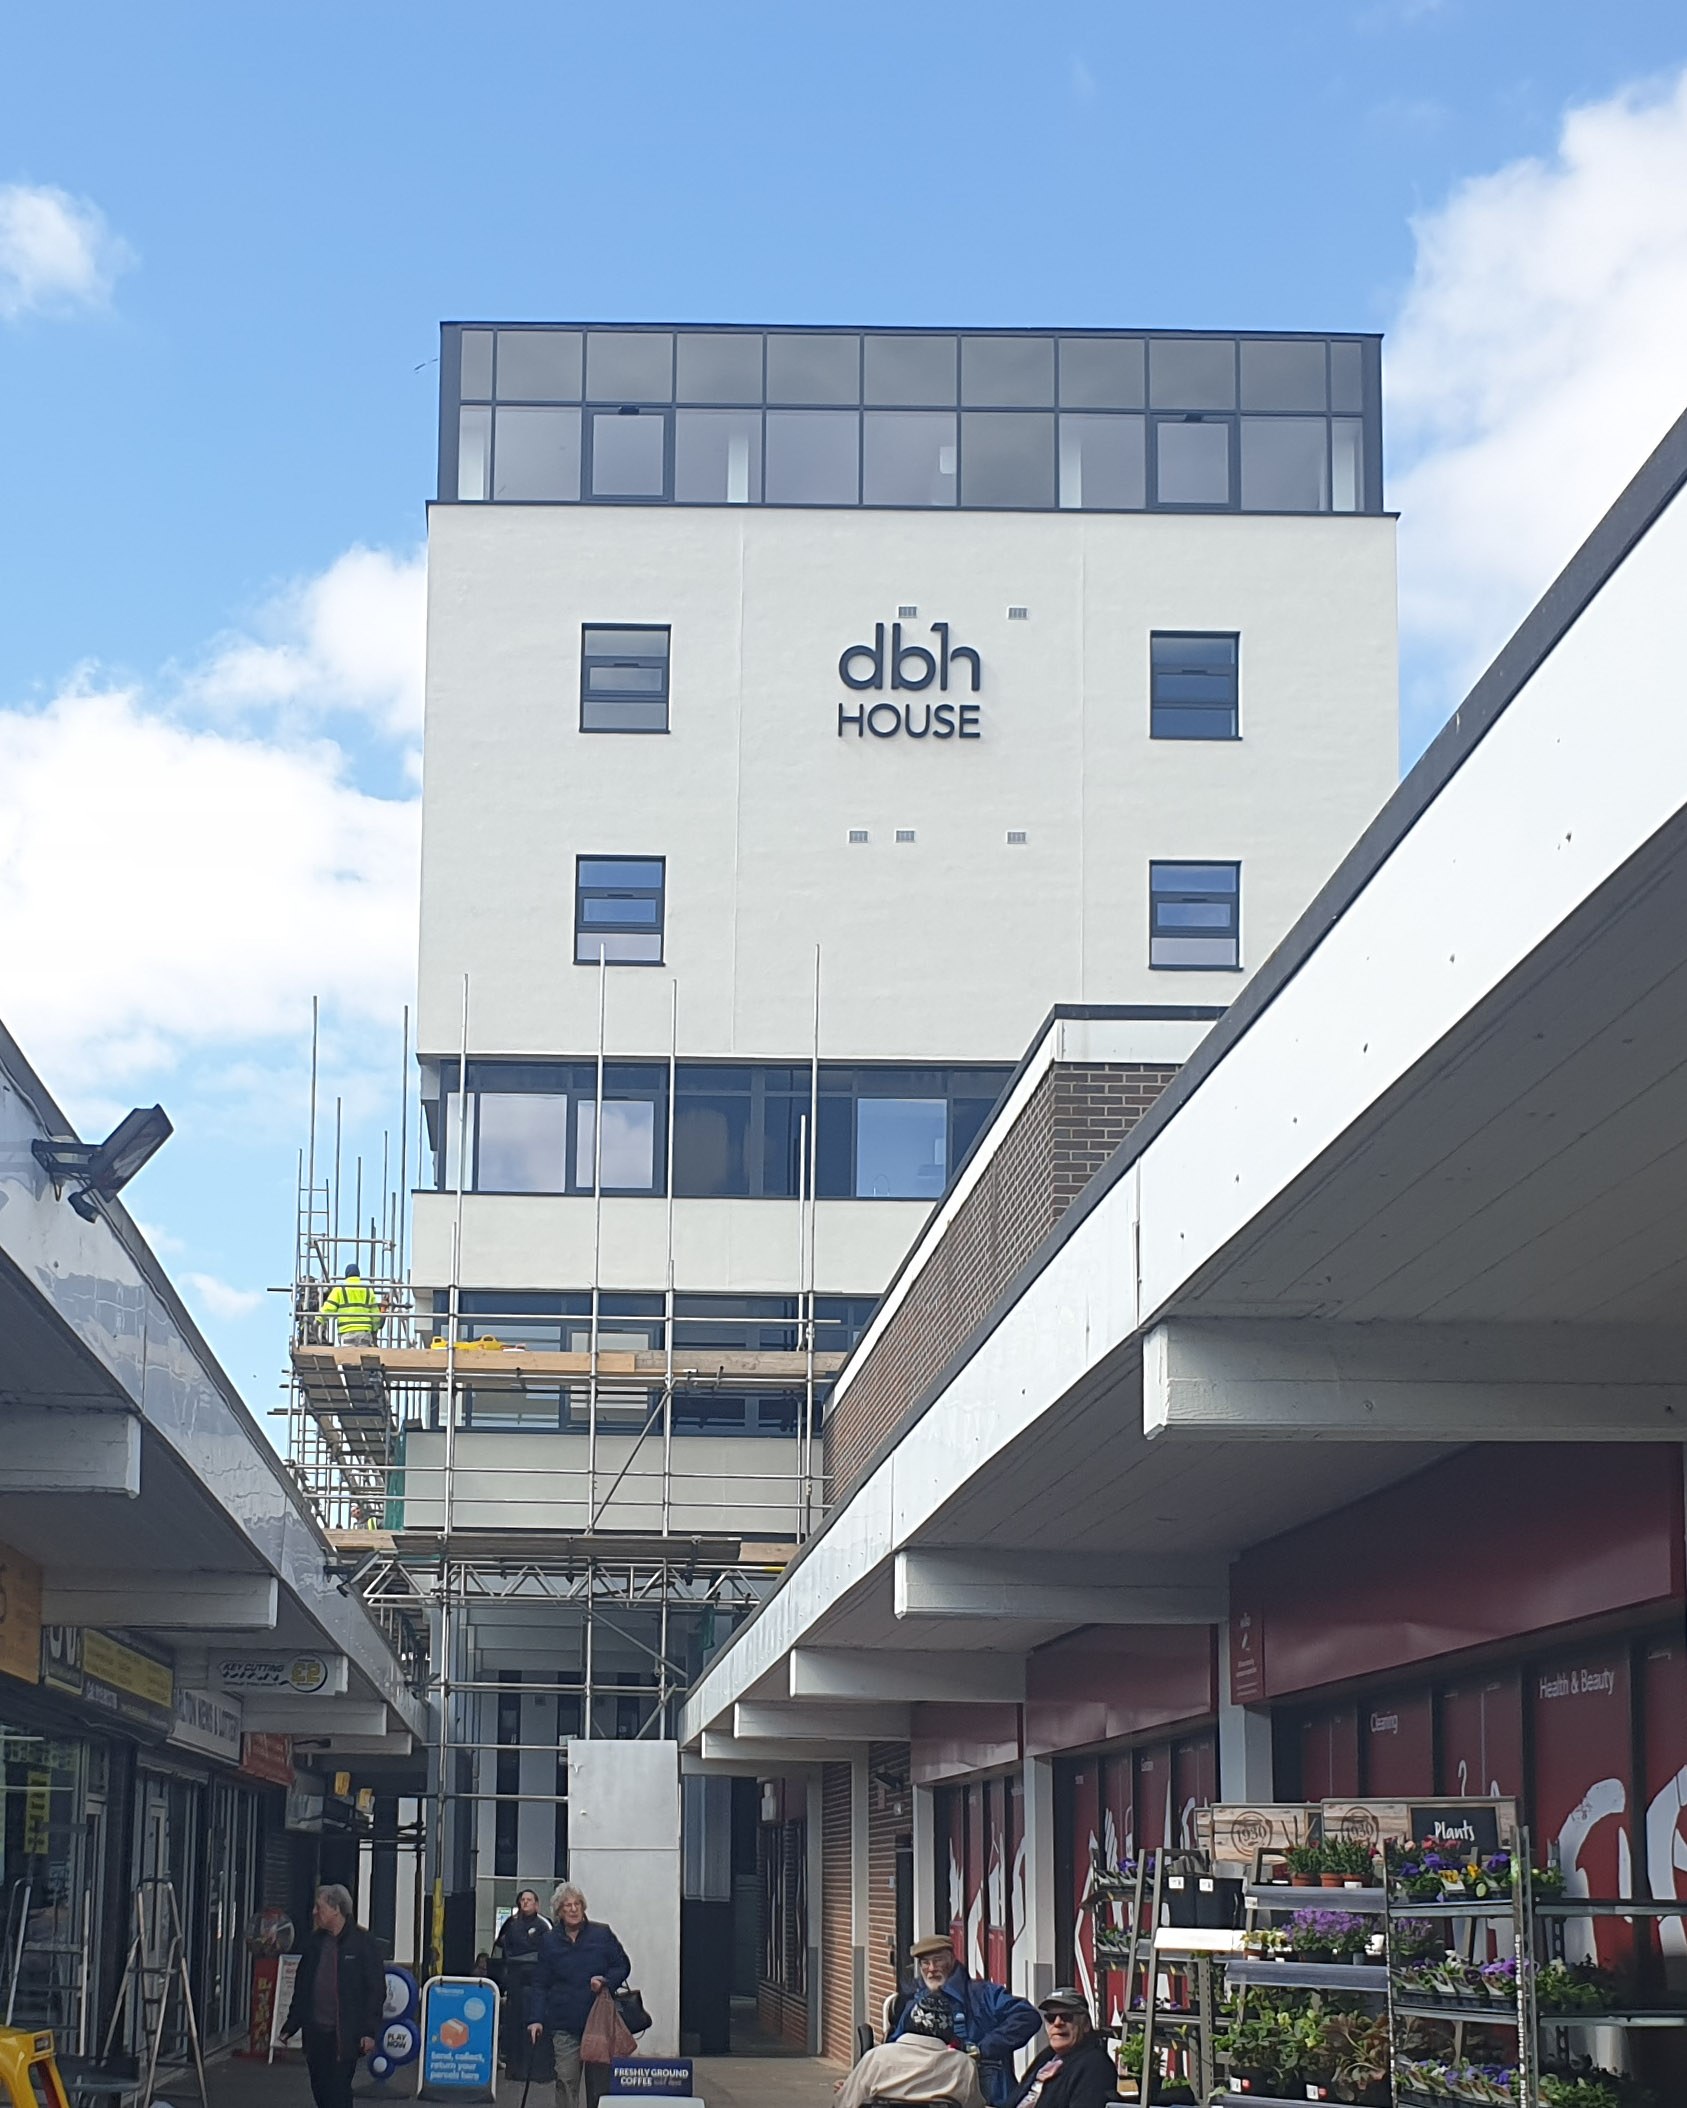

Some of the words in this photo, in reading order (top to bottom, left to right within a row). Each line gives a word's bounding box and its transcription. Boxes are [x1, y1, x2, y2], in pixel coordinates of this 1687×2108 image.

[838, 622, 981, 691] dbh
[837, 702, 981, 739] HOUSE
[222, 1662, 242, 1672] KEY
[244, 1663, 284, 1673] CUTTING
[1539, 1672, 1569, 1699] Health
[1570, 1670, 1579, 1694] &
[1581, 1668, 1615, 1696] Beauty
[1236, 1824, 1267, 1841] 1930
[1346, 1820, 1374, 1837] 1930
[1434, 1819, 1475, 1841] Plants
[386, 2041, 406, 2049] NOW
[387, 2033, 407, 2041] PLAY
[614, 2067, 650, 2077] FRESHLY
[651, 2068, 689, 2079] GROUND
[620, 2076, 652, 2087] COFFEE
